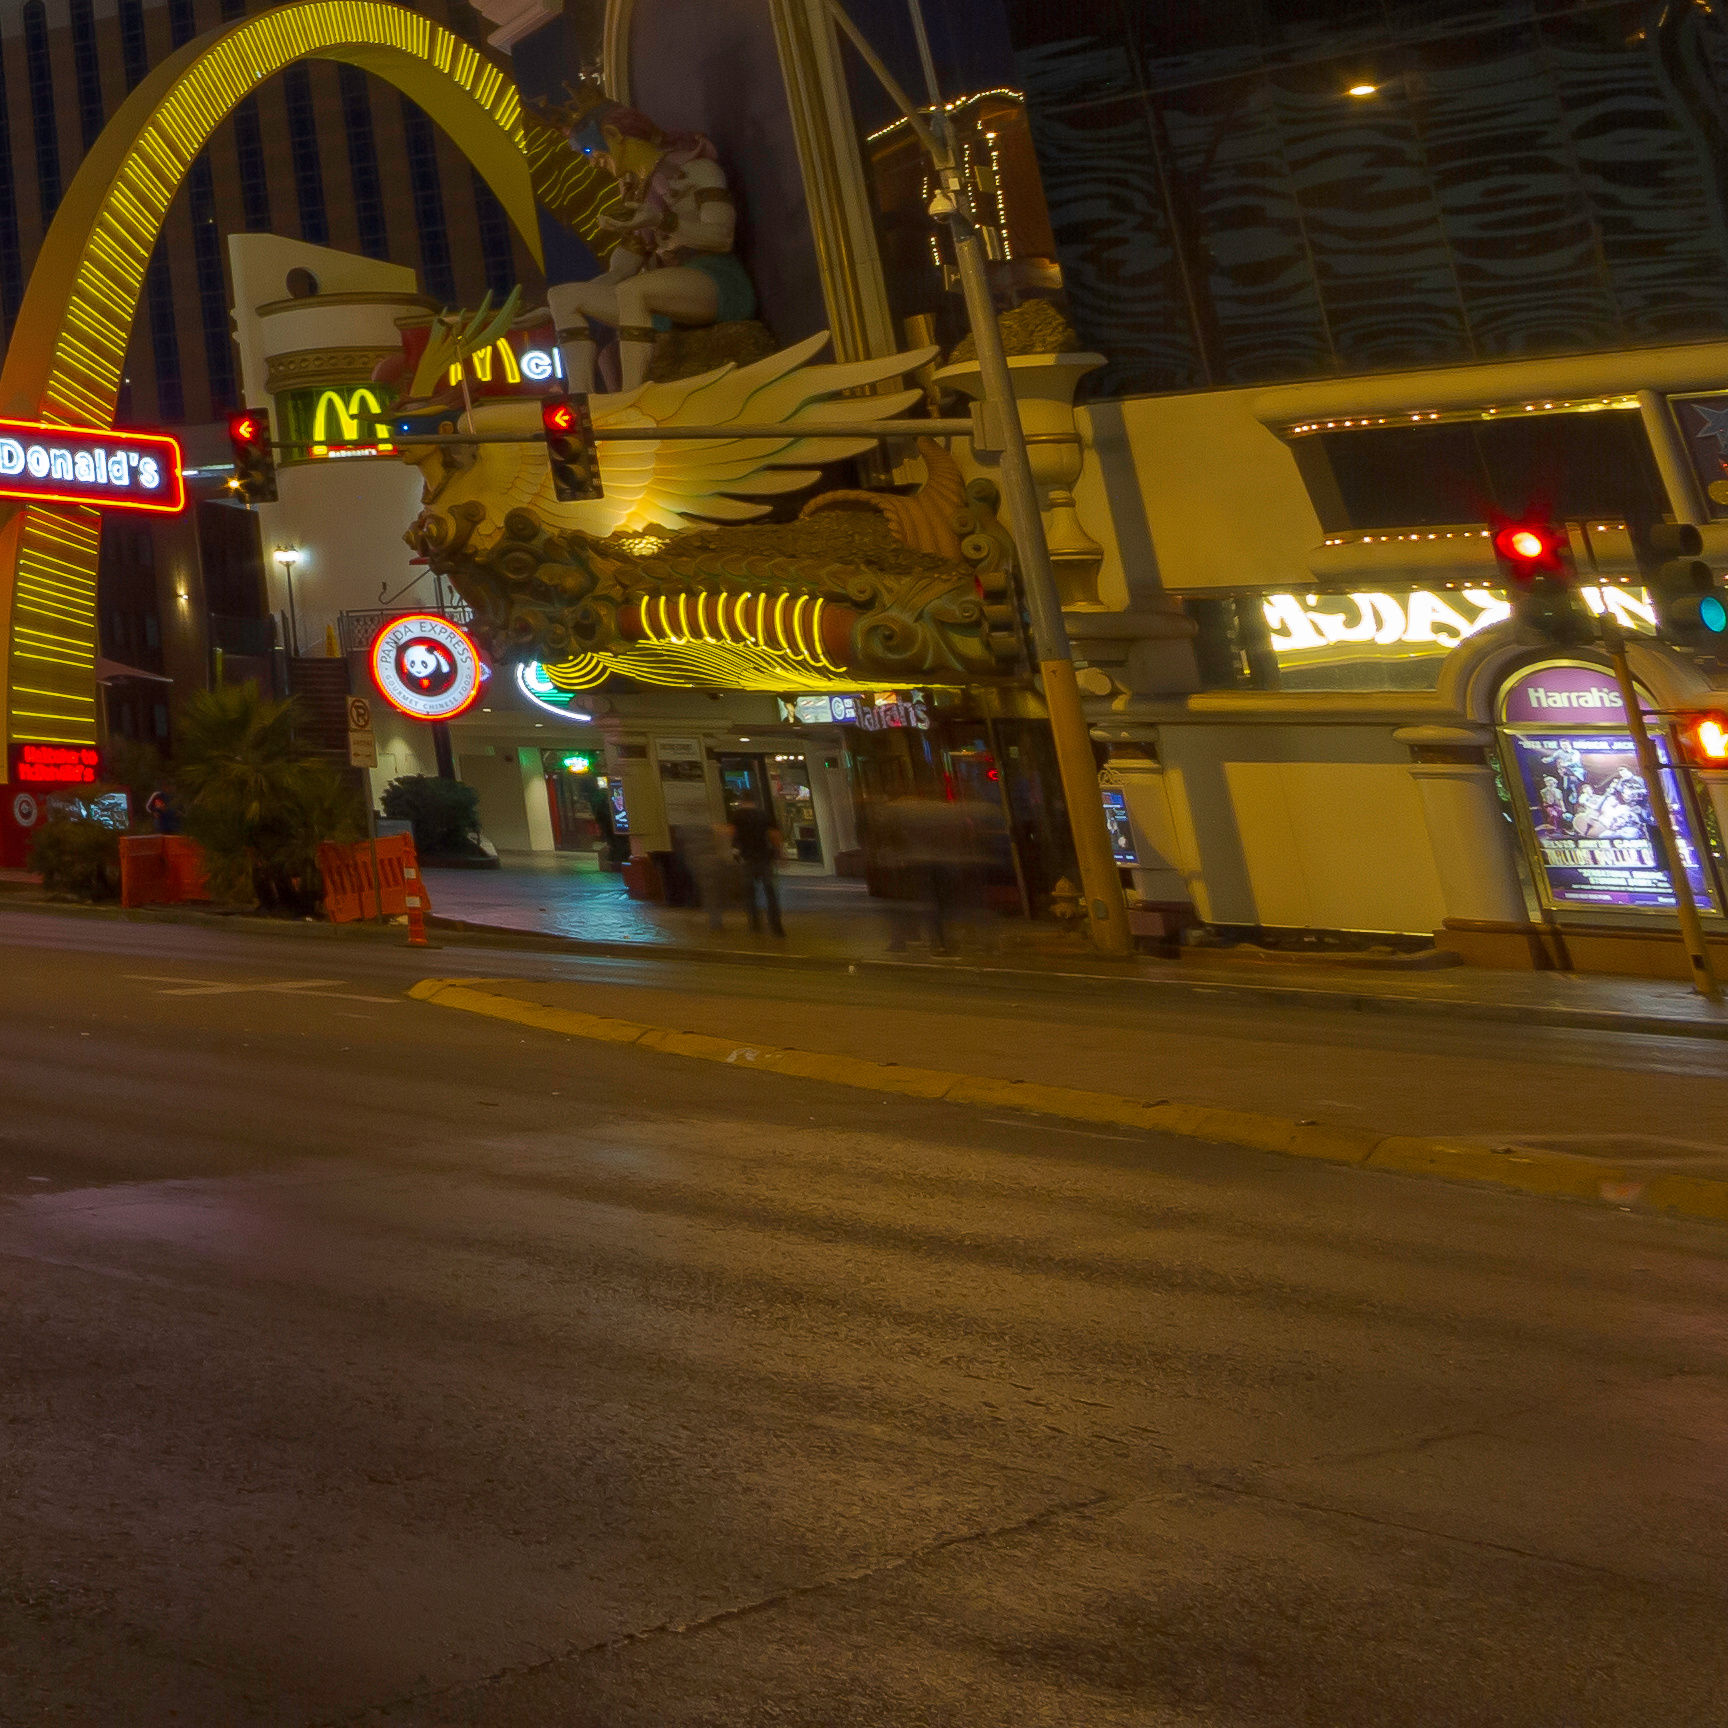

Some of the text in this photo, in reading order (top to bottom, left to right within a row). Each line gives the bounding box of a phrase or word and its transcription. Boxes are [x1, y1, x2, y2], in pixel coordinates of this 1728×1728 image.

[380, 621, 473, 665] PANDA EXPRESS
[422, 695, 459, 710] CHINESE
[1527, 687, 1625, 708] Harrah's
